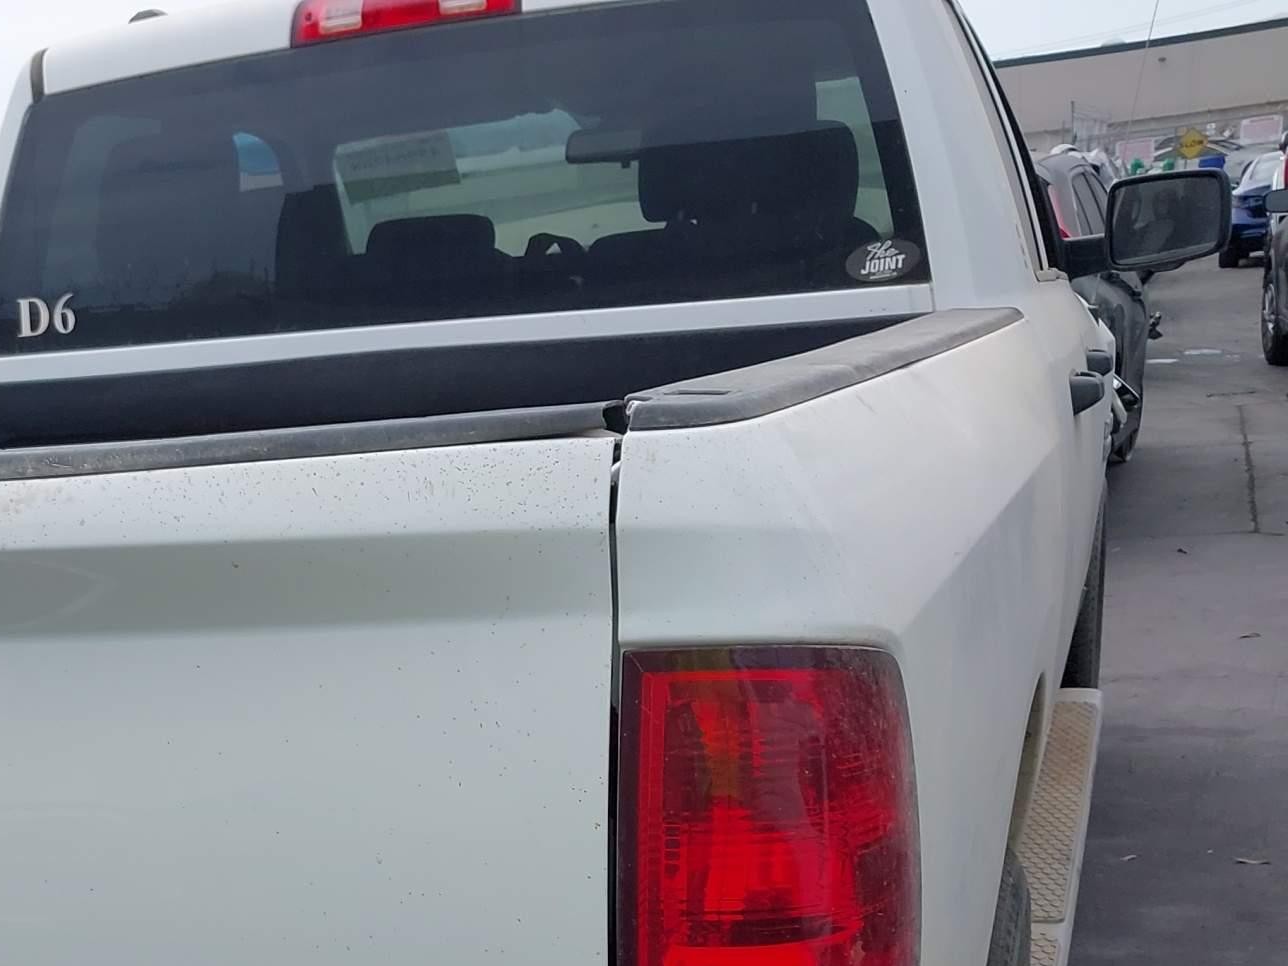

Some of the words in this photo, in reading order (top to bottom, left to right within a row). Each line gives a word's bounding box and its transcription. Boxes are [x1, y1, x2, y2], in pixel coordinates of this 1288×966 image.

[866, 239, 900, 261] The
[860, 254, 906, 275] JOINT
[16, 292, 76, 338] D6
